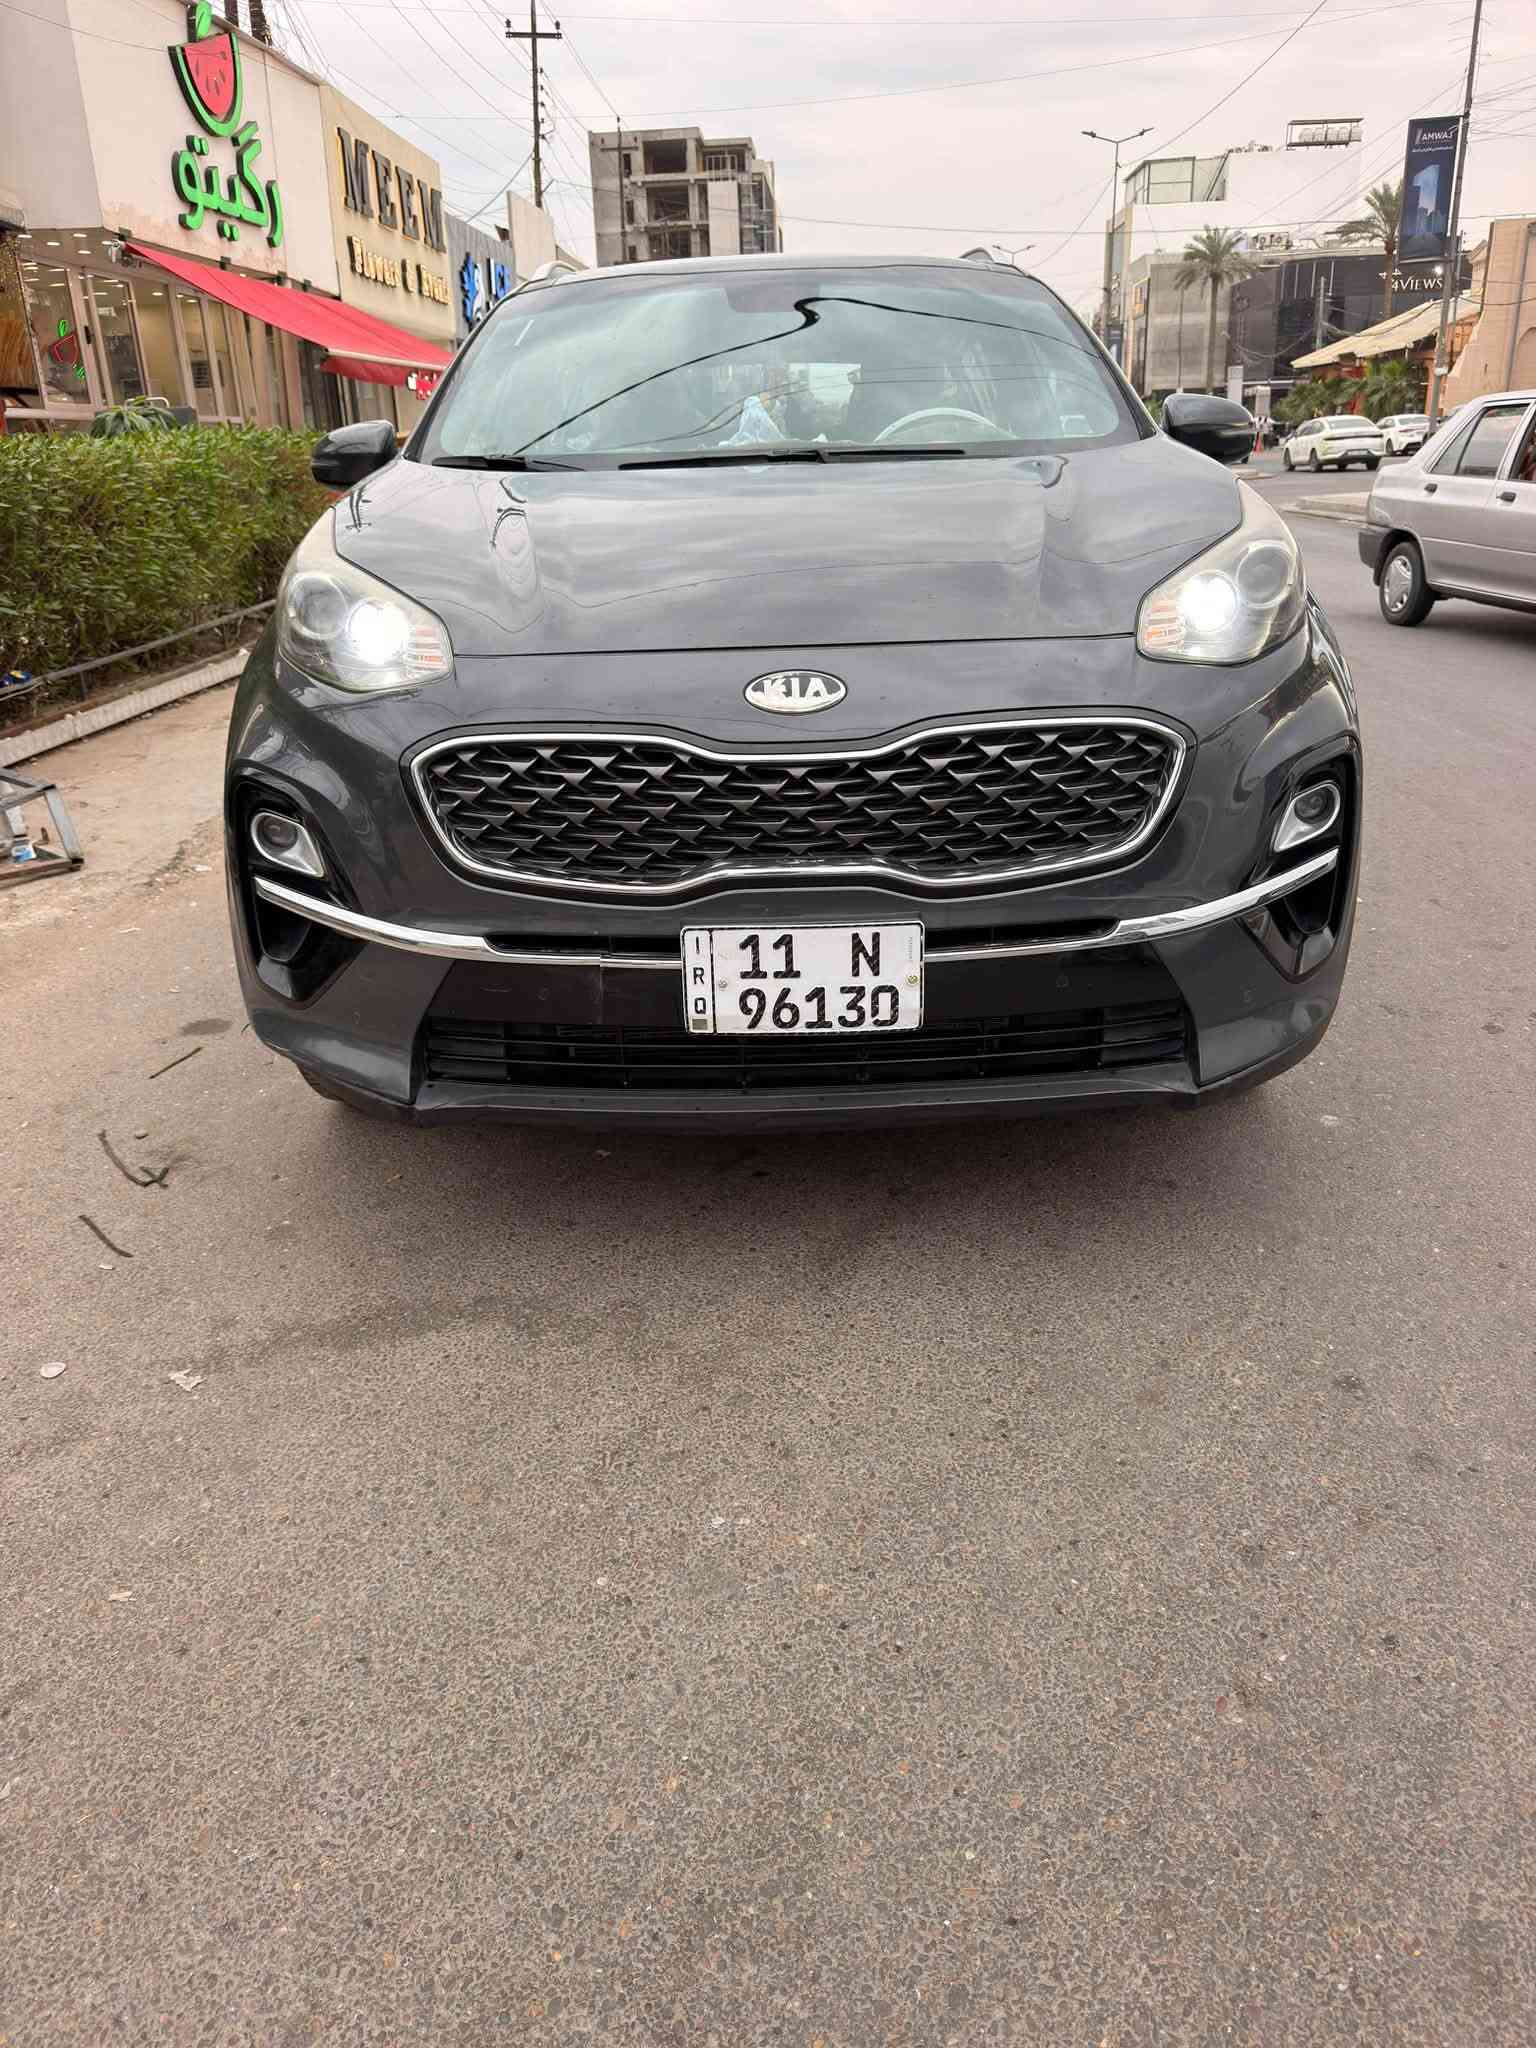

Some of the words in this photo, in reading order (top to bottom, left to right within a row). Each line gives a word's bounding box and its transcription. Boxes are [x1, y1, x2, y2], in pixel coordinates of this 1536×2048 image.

[337, 127, 446, 253] MEEM
[739, 933, 801, 980] 11
[851, 931, 881, 977] N
[739, 984, 899, 1030] 96130
